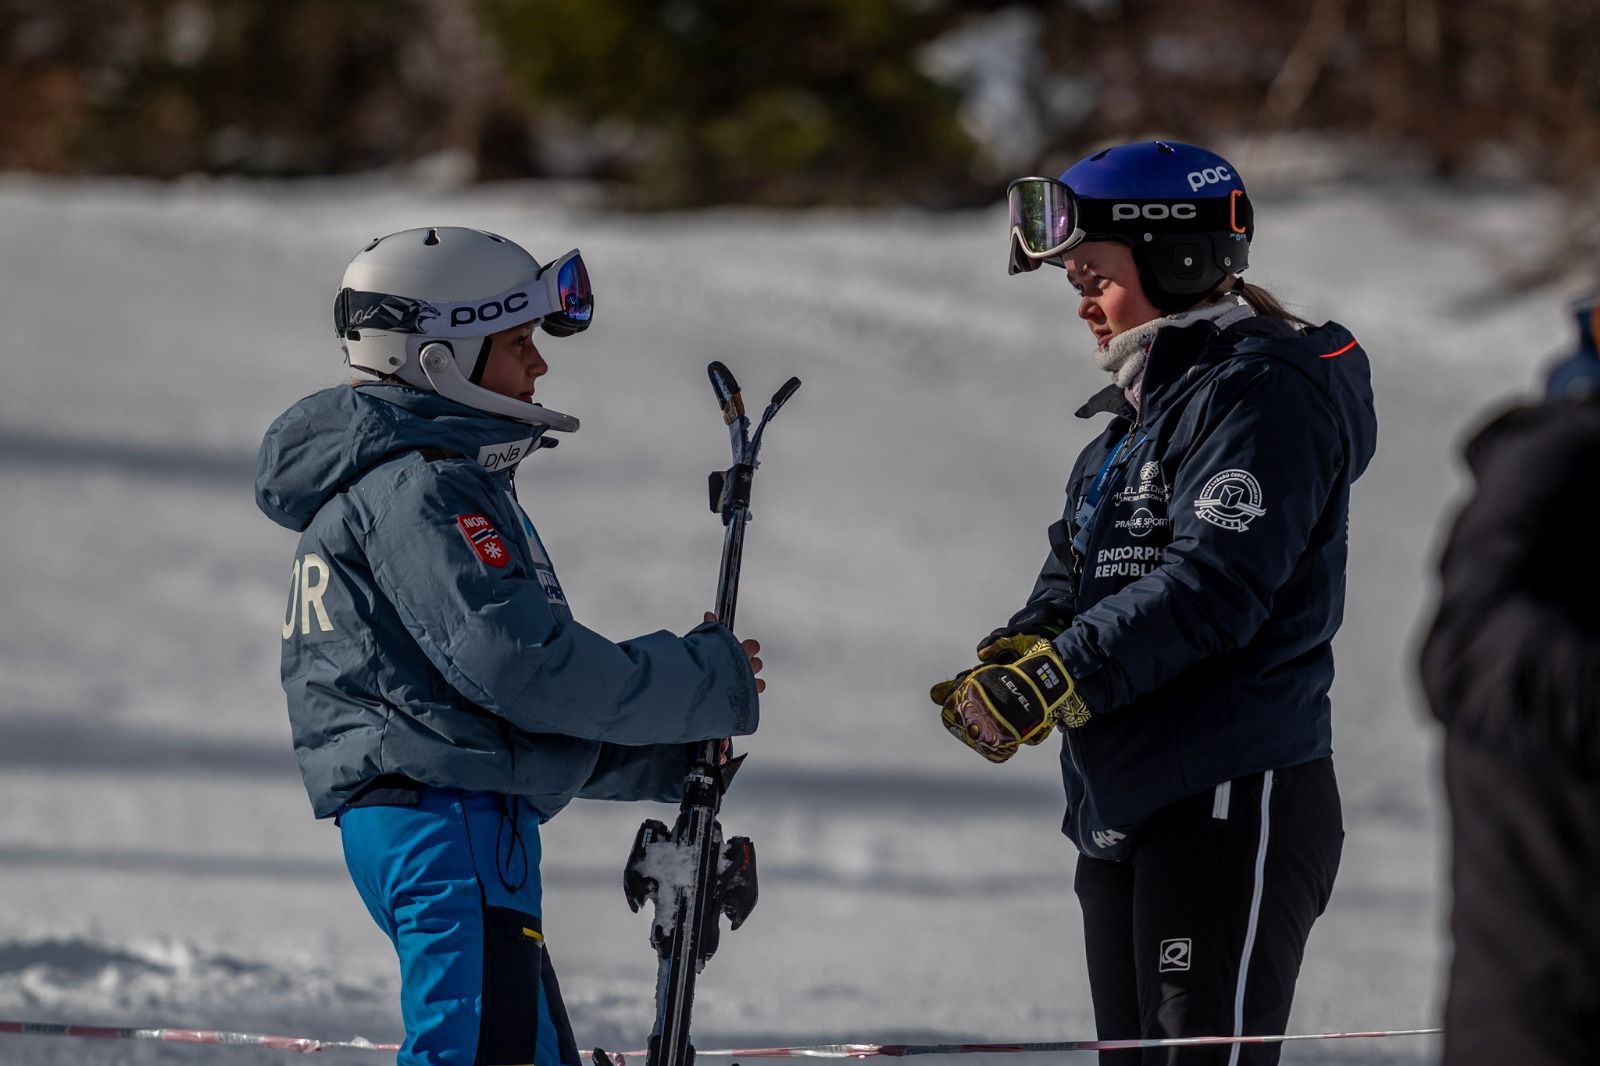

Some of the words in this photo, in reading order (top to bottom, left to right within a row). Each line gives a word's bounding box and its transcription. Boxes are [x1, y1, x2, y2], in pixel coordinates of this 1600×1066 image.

[484, 444, 521, 470] DNB
[463, 516, 489, 528] NOR
[1115, 517, 1142, 528] PRAGUE
[1143, 517, 1169, 527] SPORT
[1000, 675, 1032, 712] LEVEL
